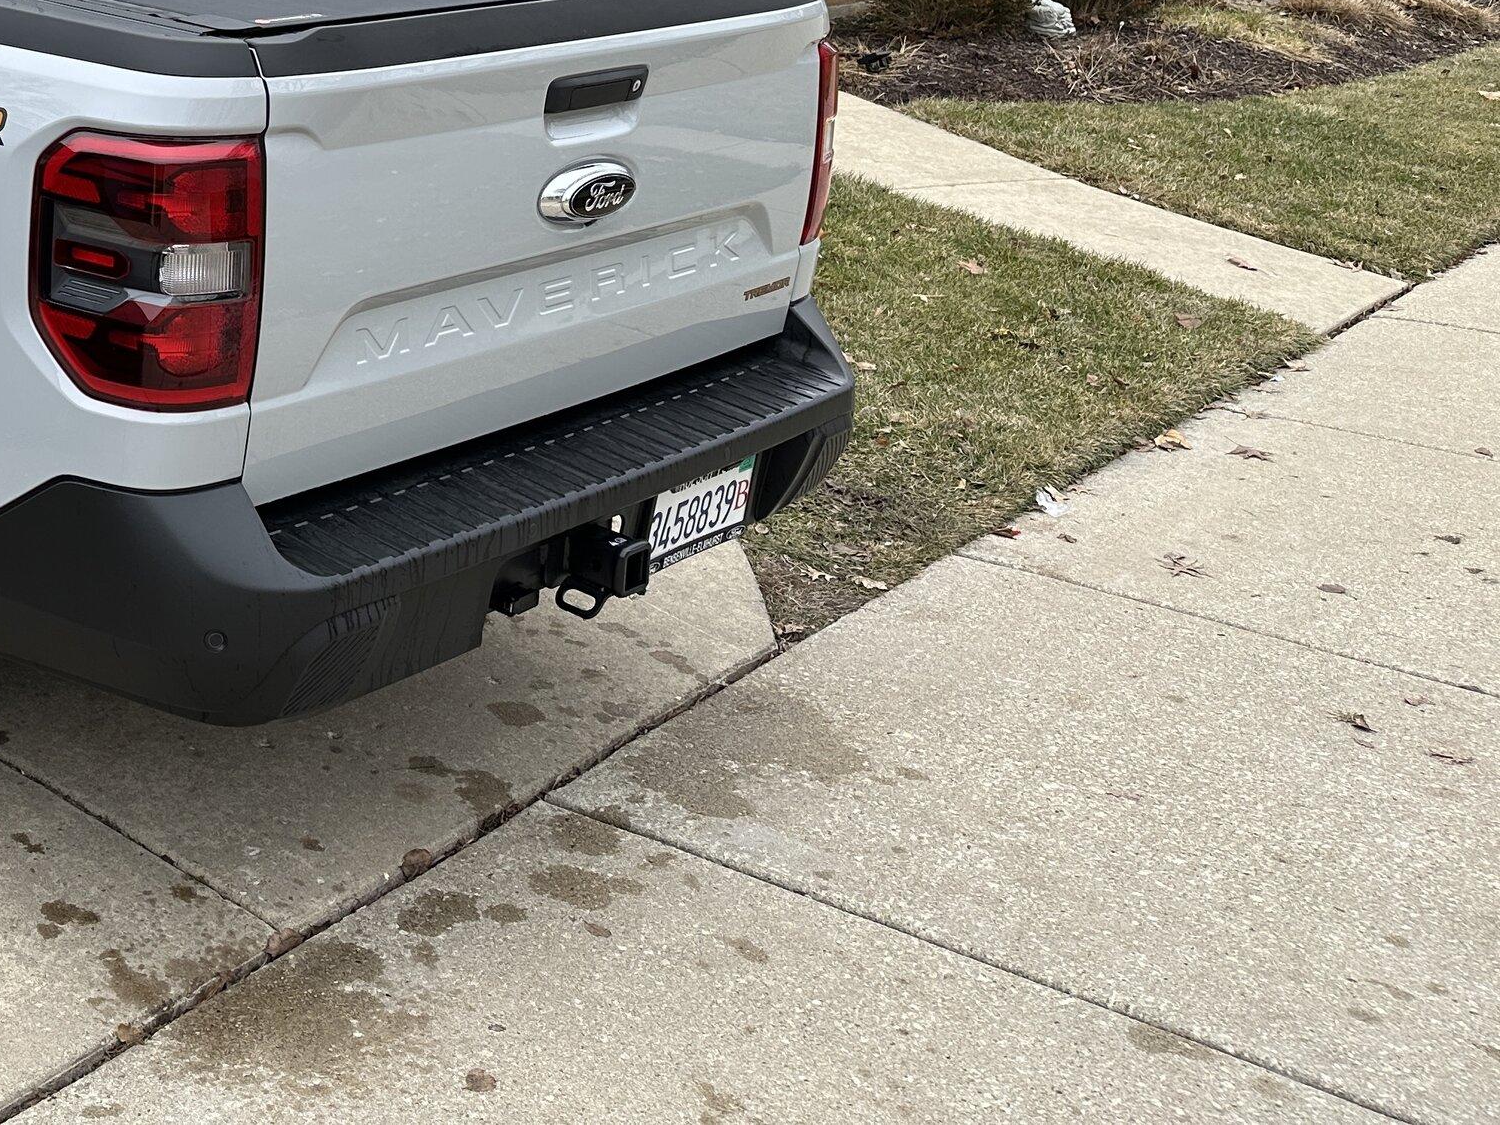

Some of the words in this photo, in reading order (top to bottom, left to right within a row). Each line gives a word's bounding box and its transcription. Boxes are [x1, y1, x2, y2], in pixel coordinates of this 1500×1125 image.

[585, 180, 626, 212] Ford
[355, 230, 740, 366] MAVERICK
[743, 276, 791, 302] TREMOR
